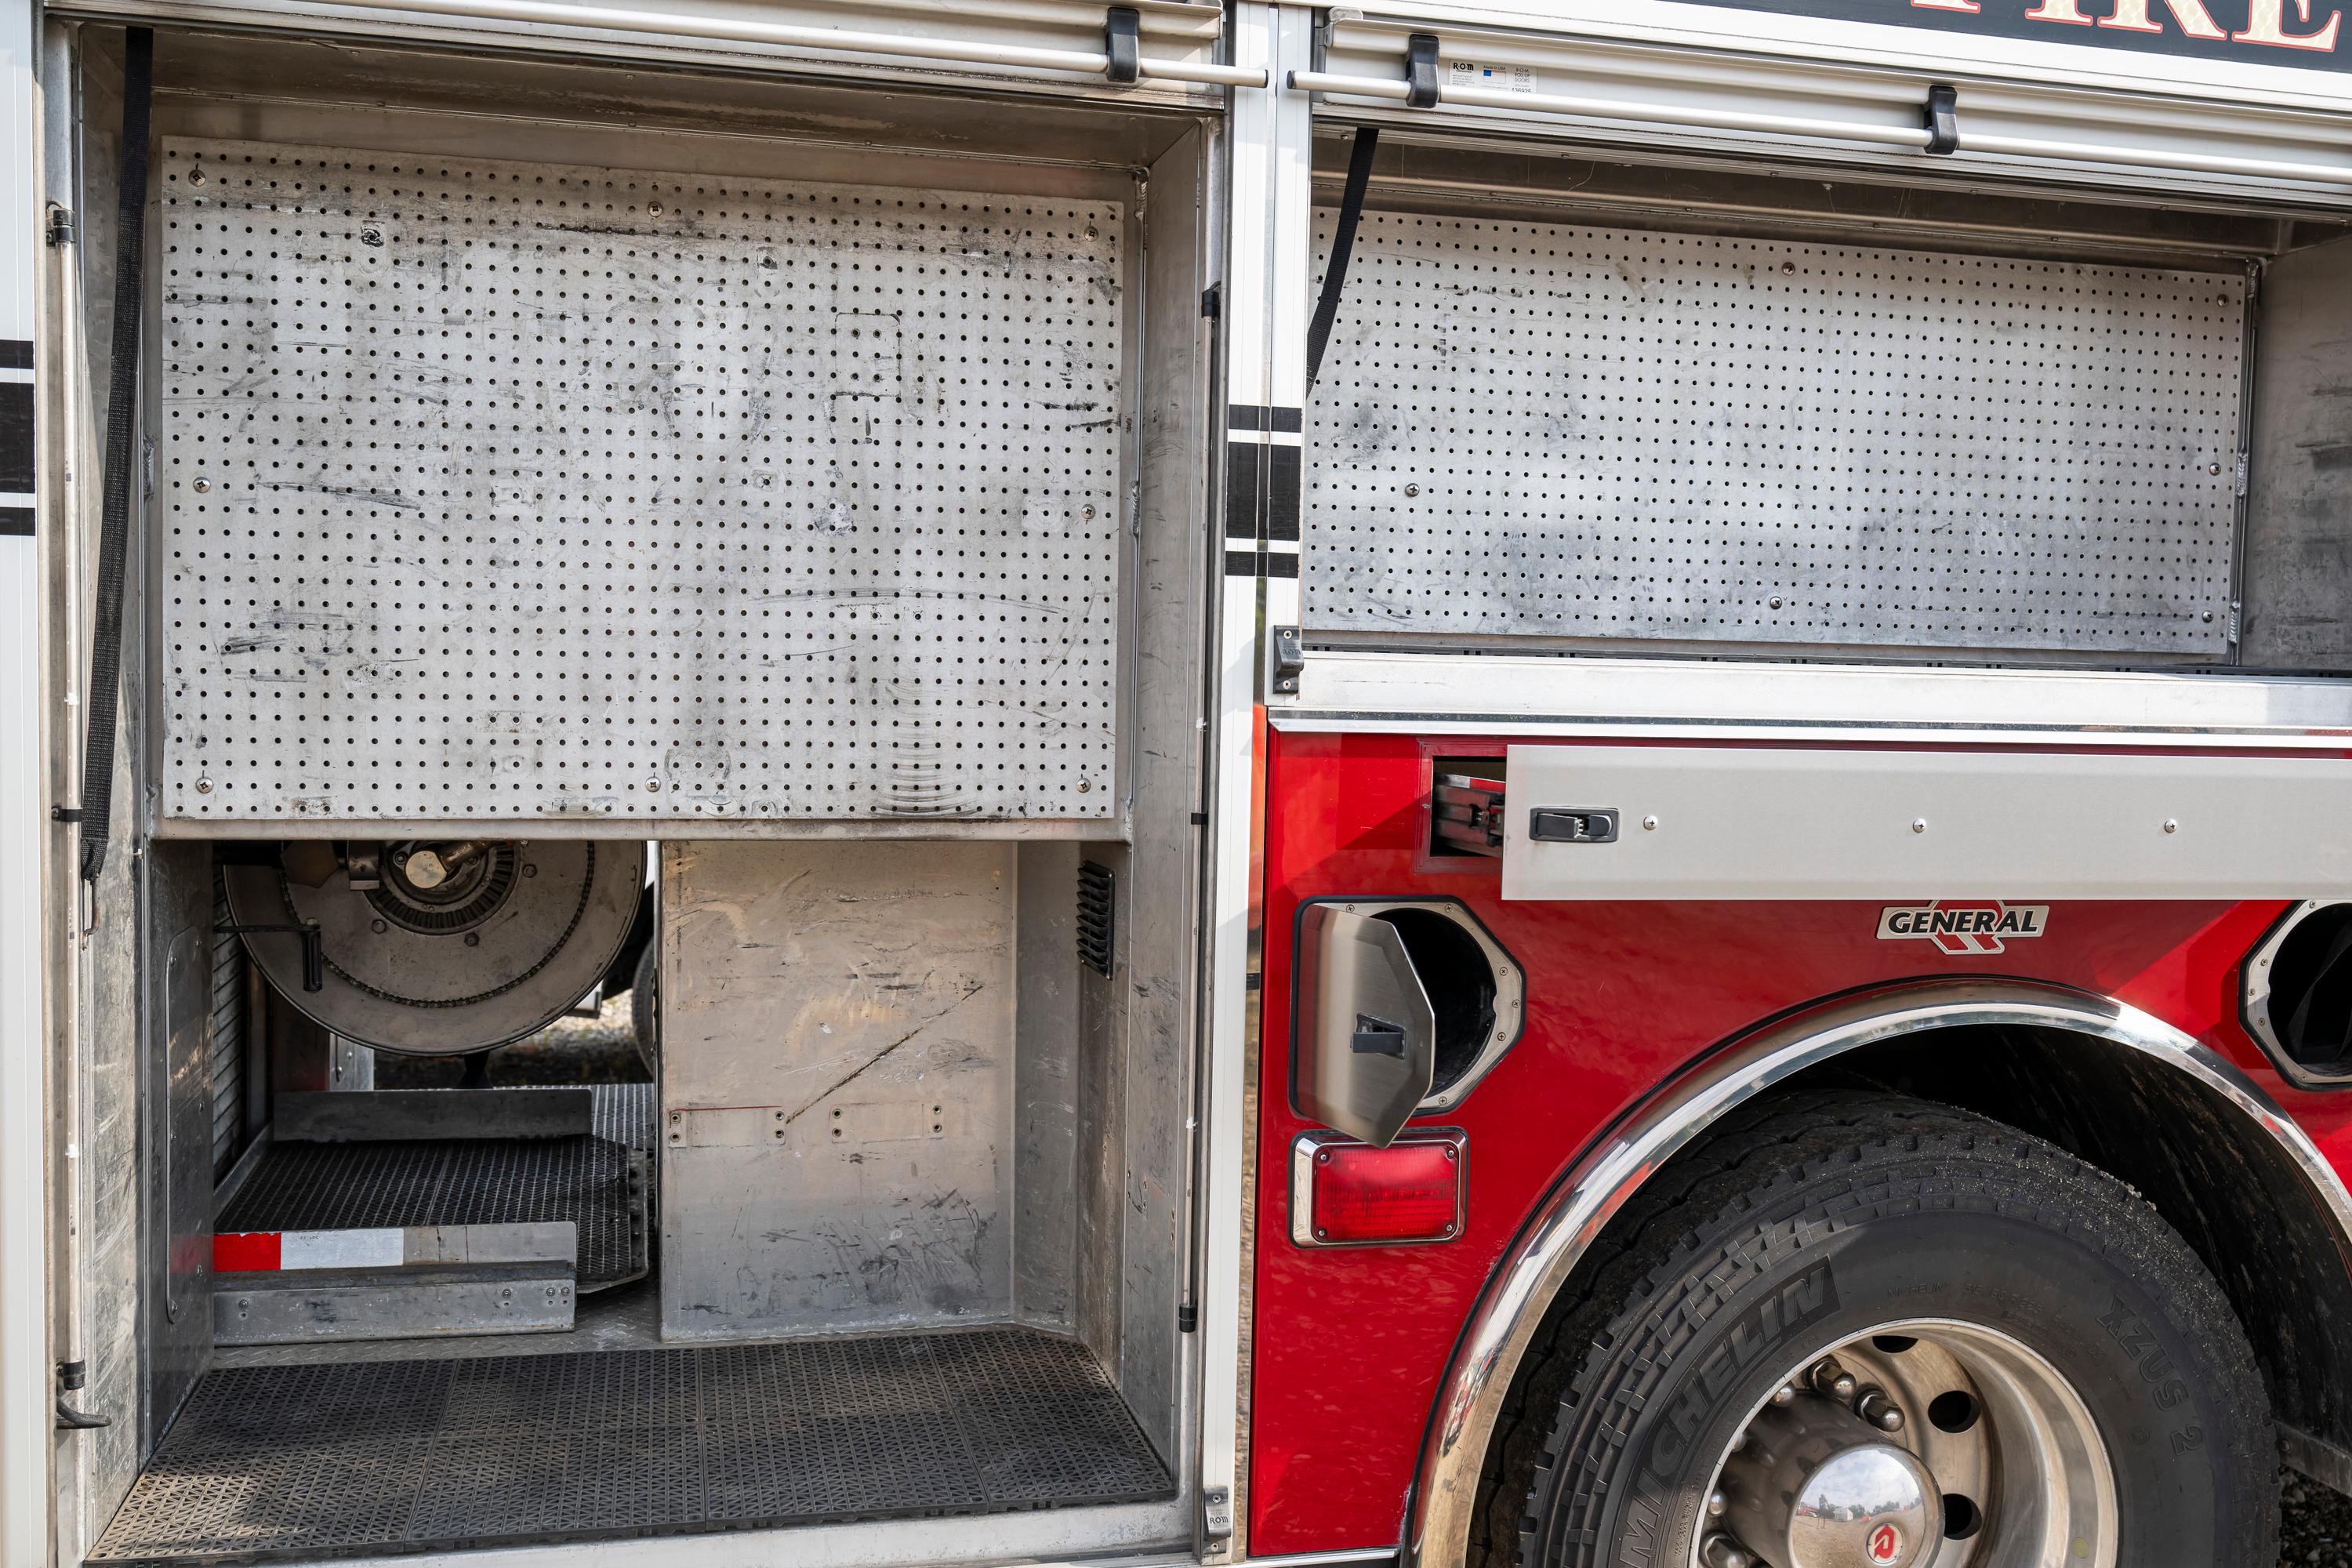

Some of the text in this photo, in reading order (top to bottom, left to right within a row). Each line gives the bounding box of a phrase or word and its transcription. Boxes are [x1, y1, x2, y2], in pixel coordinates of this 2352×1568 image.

[1888, 911, 2038, 933] GENERAL
[1619, 1266, 1825, 1568] MICHELIN
[2096, 1294, 2204, 1456] XZUS 2
